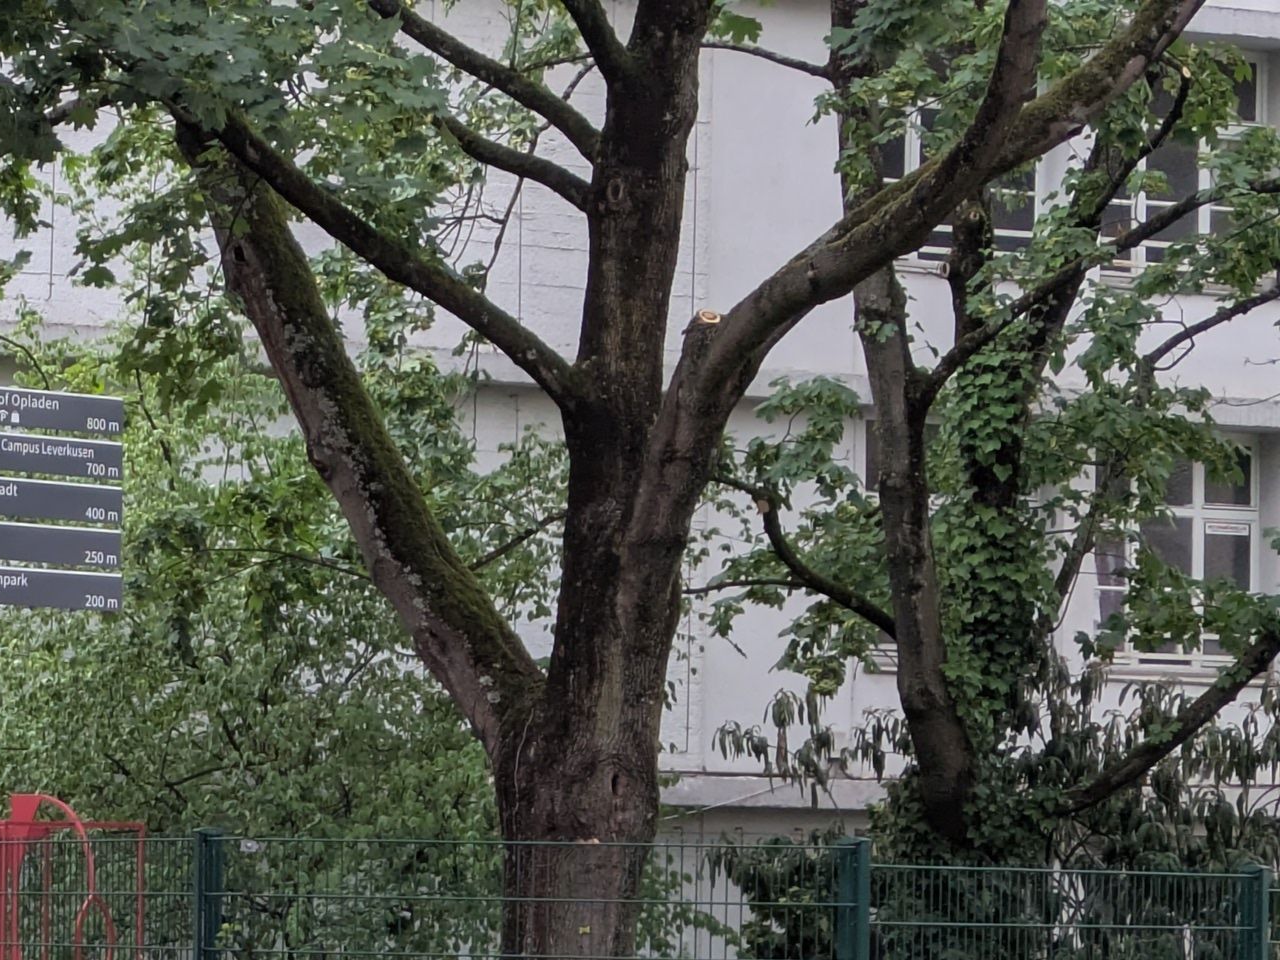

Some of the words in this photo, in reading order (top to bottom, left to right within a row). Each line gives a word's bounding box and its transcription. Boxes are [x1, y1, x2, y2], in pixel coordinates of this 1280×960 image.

[11, 394, 60, 411] Opladen
[86, 417, 106, 431] 800
[108, 421, 120, 432] m
[1, 439, 40, 456] Campus
[41, 443, 95, 459] Leverkusen
[86, 463, 105, 476] 700
[107, 467, 119, 477] m
[85, 507, 105, 521] 400
[107, 511, 118, 521] m
[85, 551, 104, 564] 250
[106, 554, 117, 565] m
[85, 595, 104, 608] 200
[107, 598, 118, 608] m
